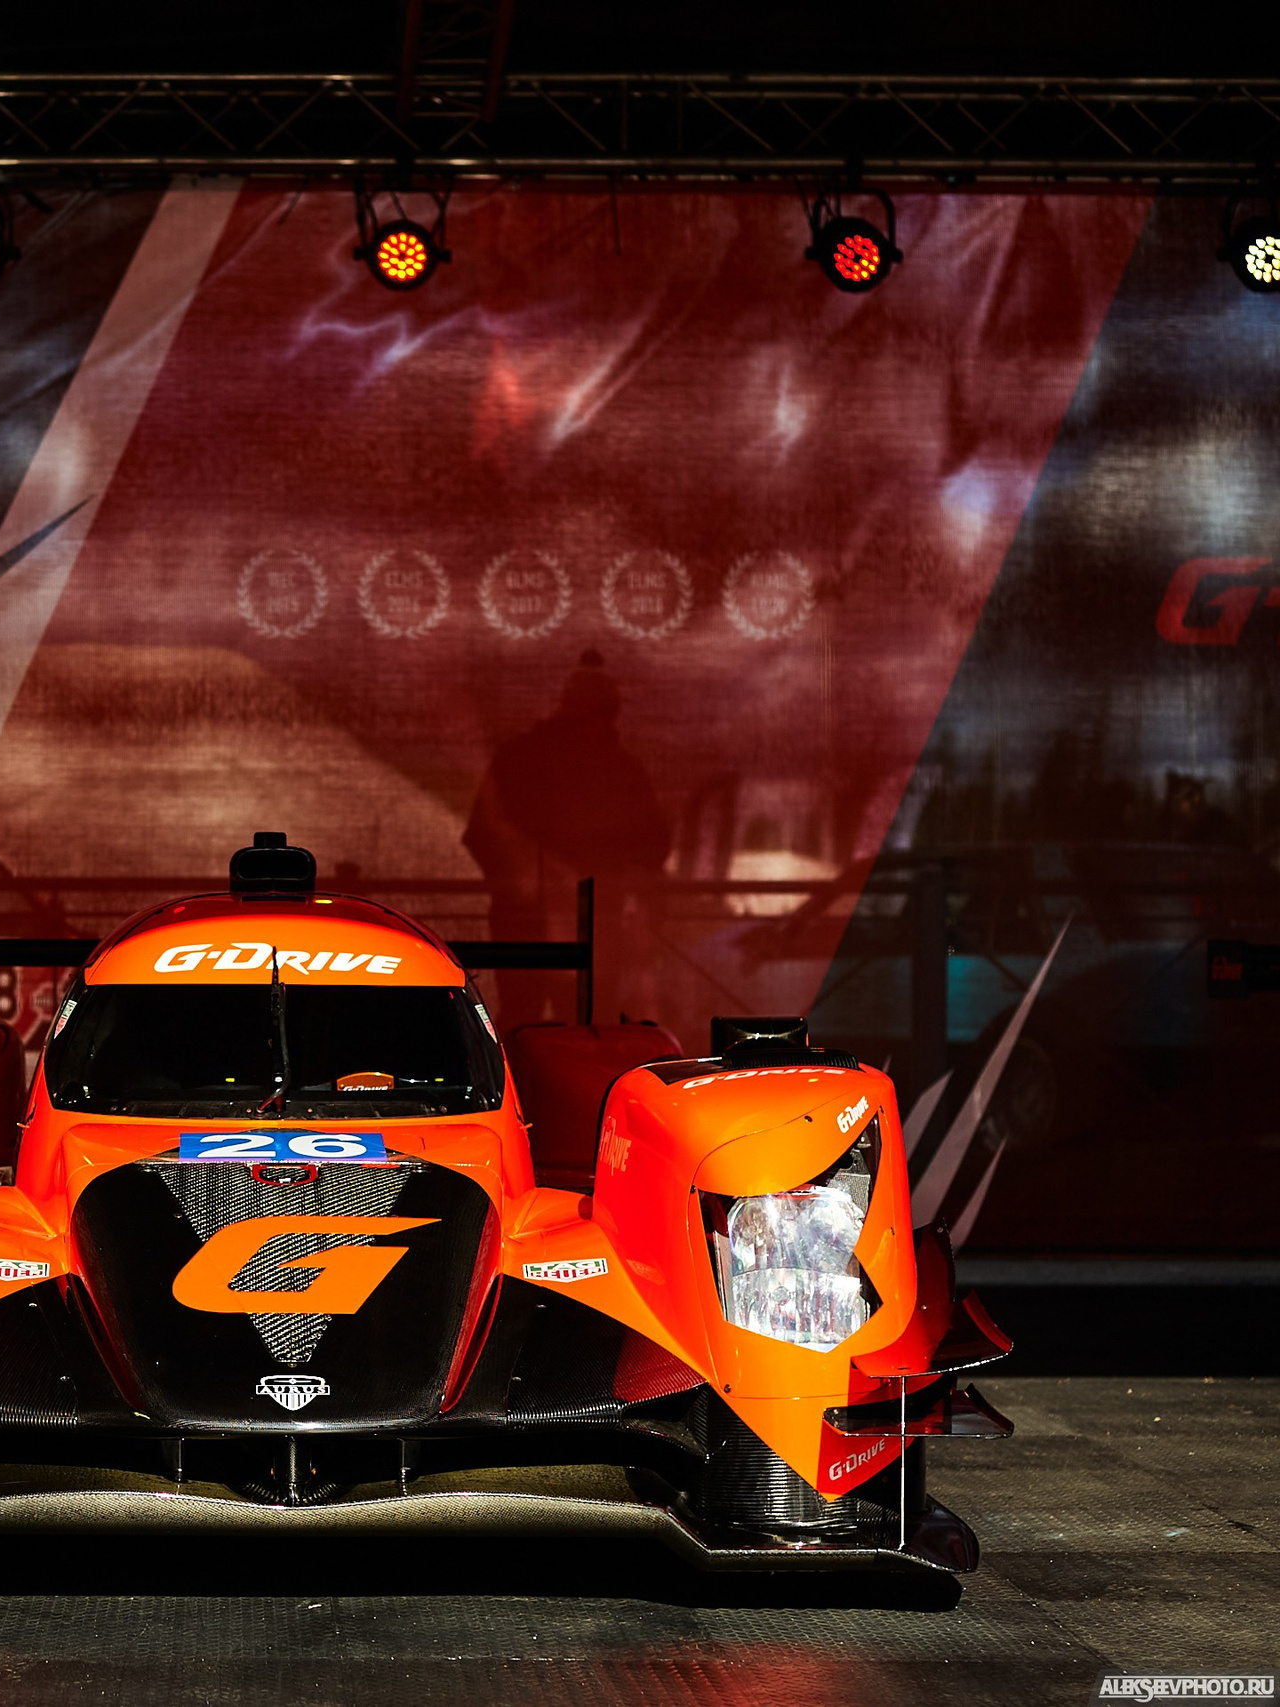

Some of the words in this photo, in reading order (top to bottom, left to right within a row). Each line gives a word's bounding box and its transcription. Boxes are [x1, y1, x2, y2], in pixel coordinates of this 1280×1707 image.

[197, 1134, 367, 1158] 26
[529, 1259, 600, 1272] TAG
[529, 1266, 601, 1279] HEUER
[260, 1385, 326, 1395] AURUS
